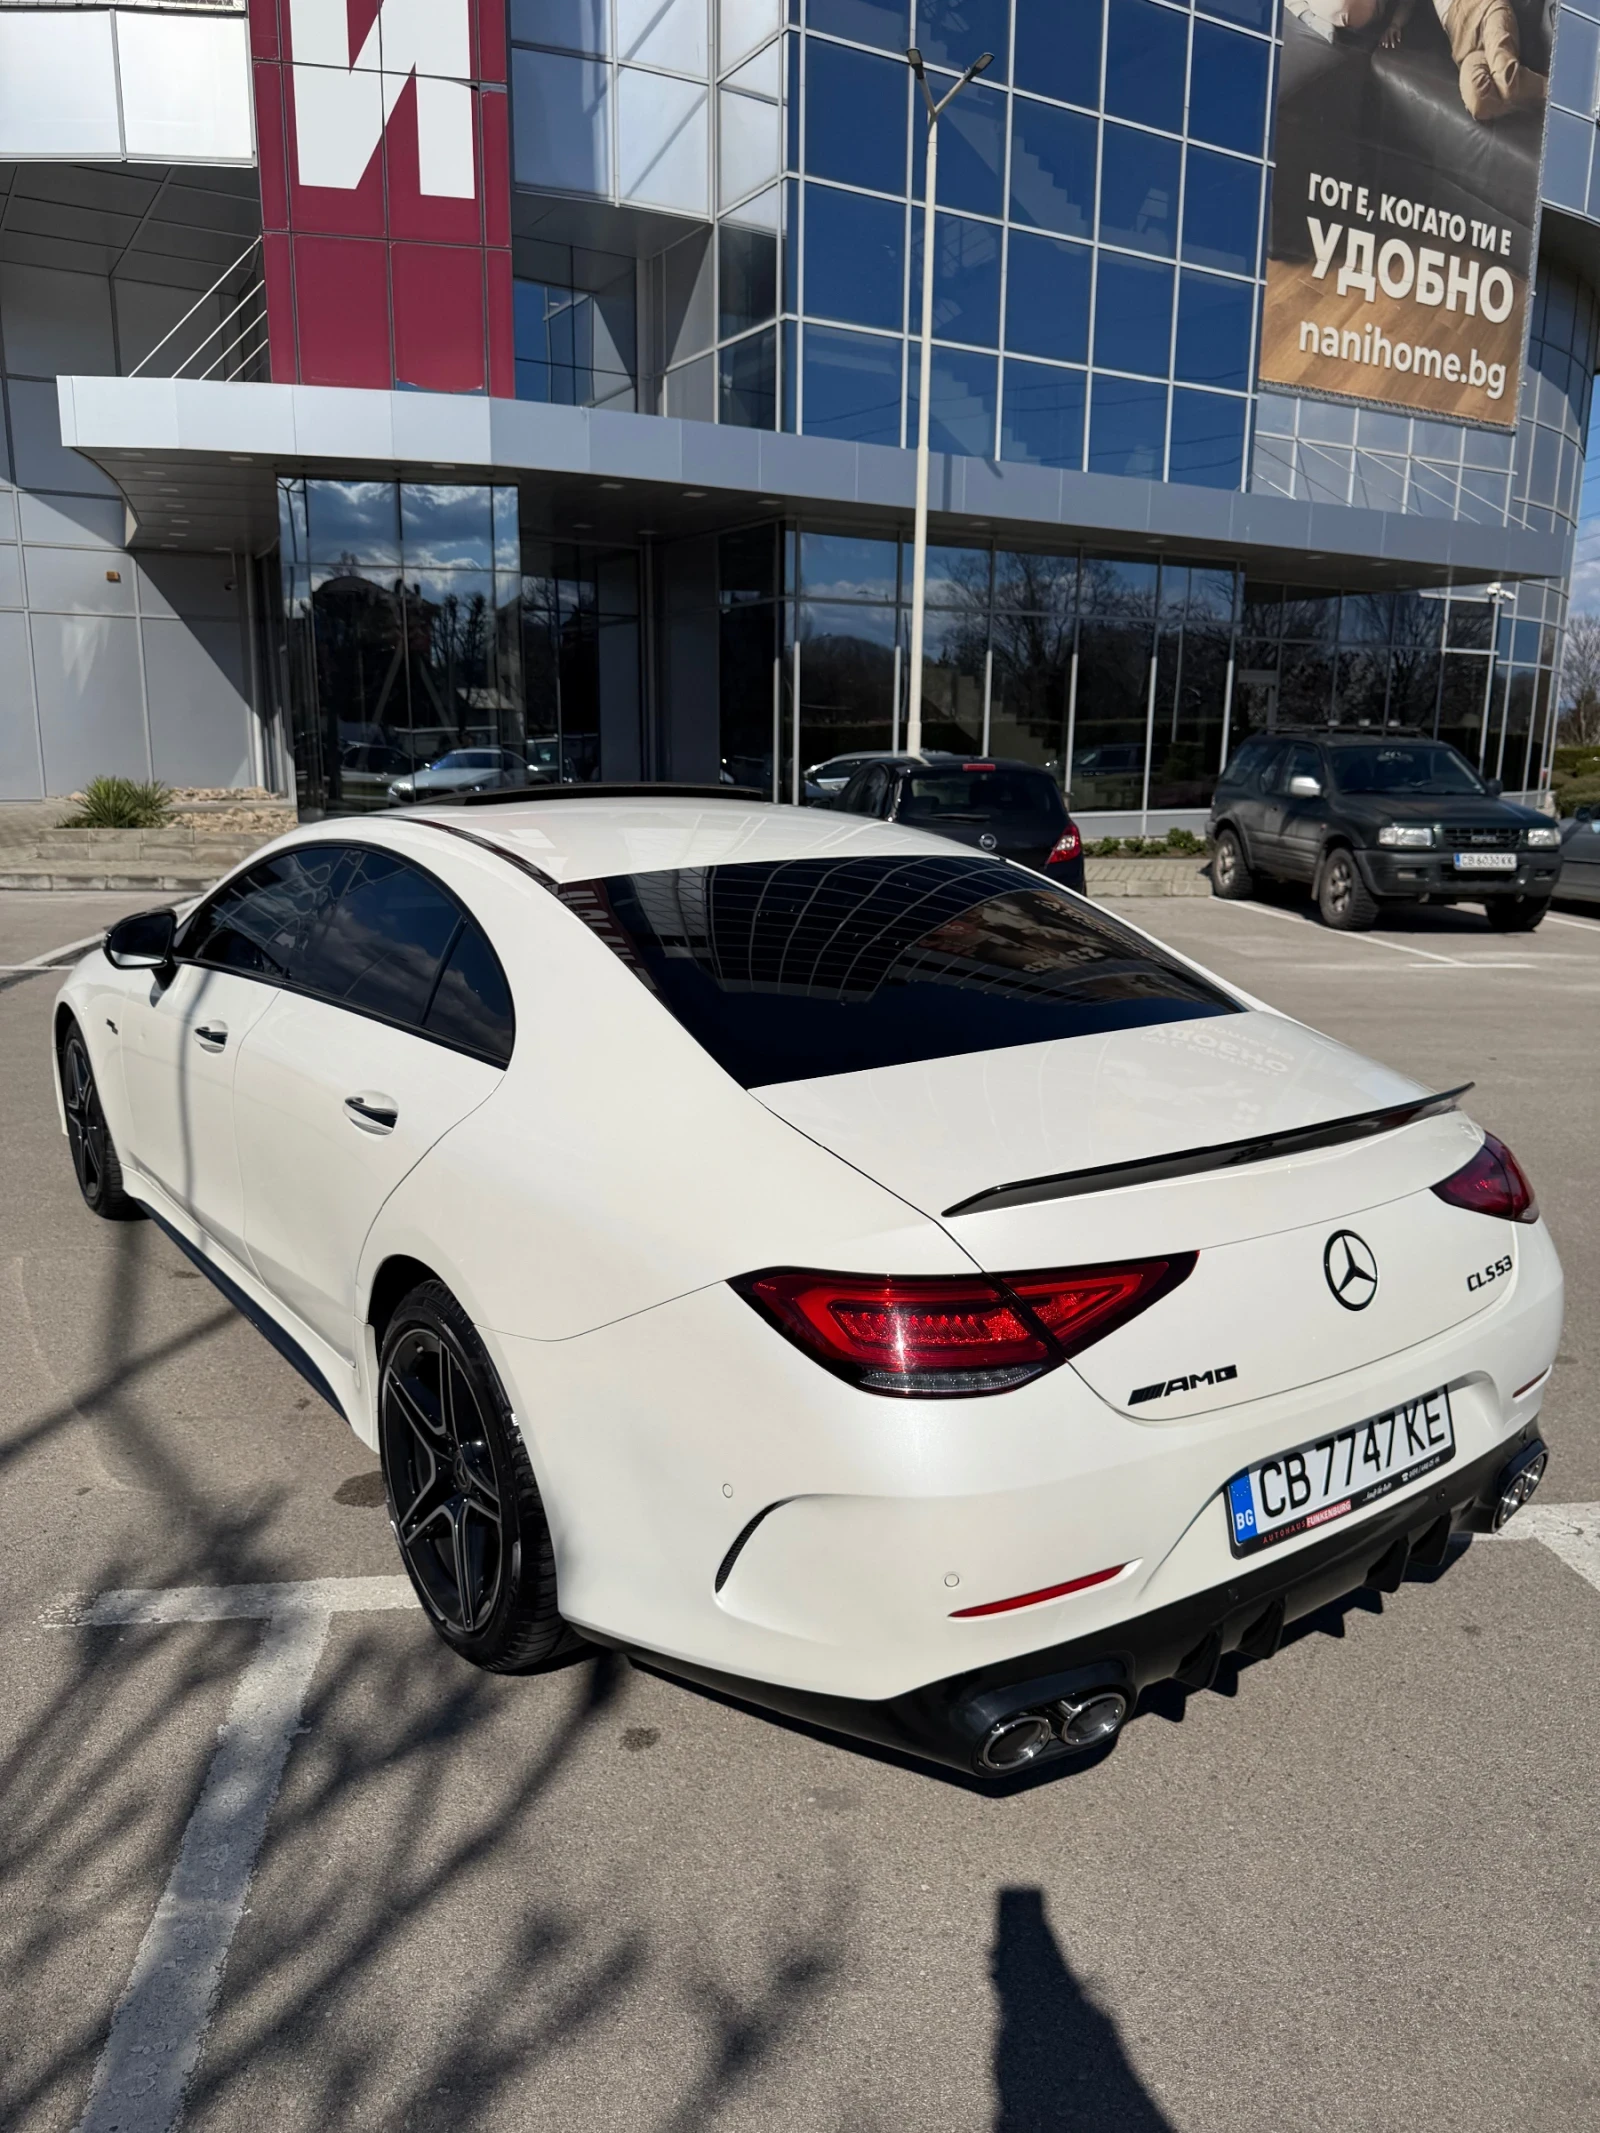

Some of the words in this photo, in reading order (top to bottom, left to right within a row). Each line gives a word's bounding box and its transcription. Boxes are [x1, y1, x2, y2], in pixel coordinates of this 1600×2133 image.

[1308, 172, 1353, 211] ГОТ
[1380, 193, 1467, 243] КОГАТО
[1470, 219, 1497, 253] ТИ
[1500, 227, 1512, 256] Е
[1306, 216, 1514, 323] УДОБНО
[1300, 320, 1506, 400] nanihome.bg
[1467, 1254, 1512, 1292] CLS53
[1164, 1365, 1238, 1397] AMG
[1236, 1508, 1254, 1531] BG
[1263, 1520, 1306, 1544] AUTOHAUS
[1307, 1501, 1352, 1527] FUNKENBURG
